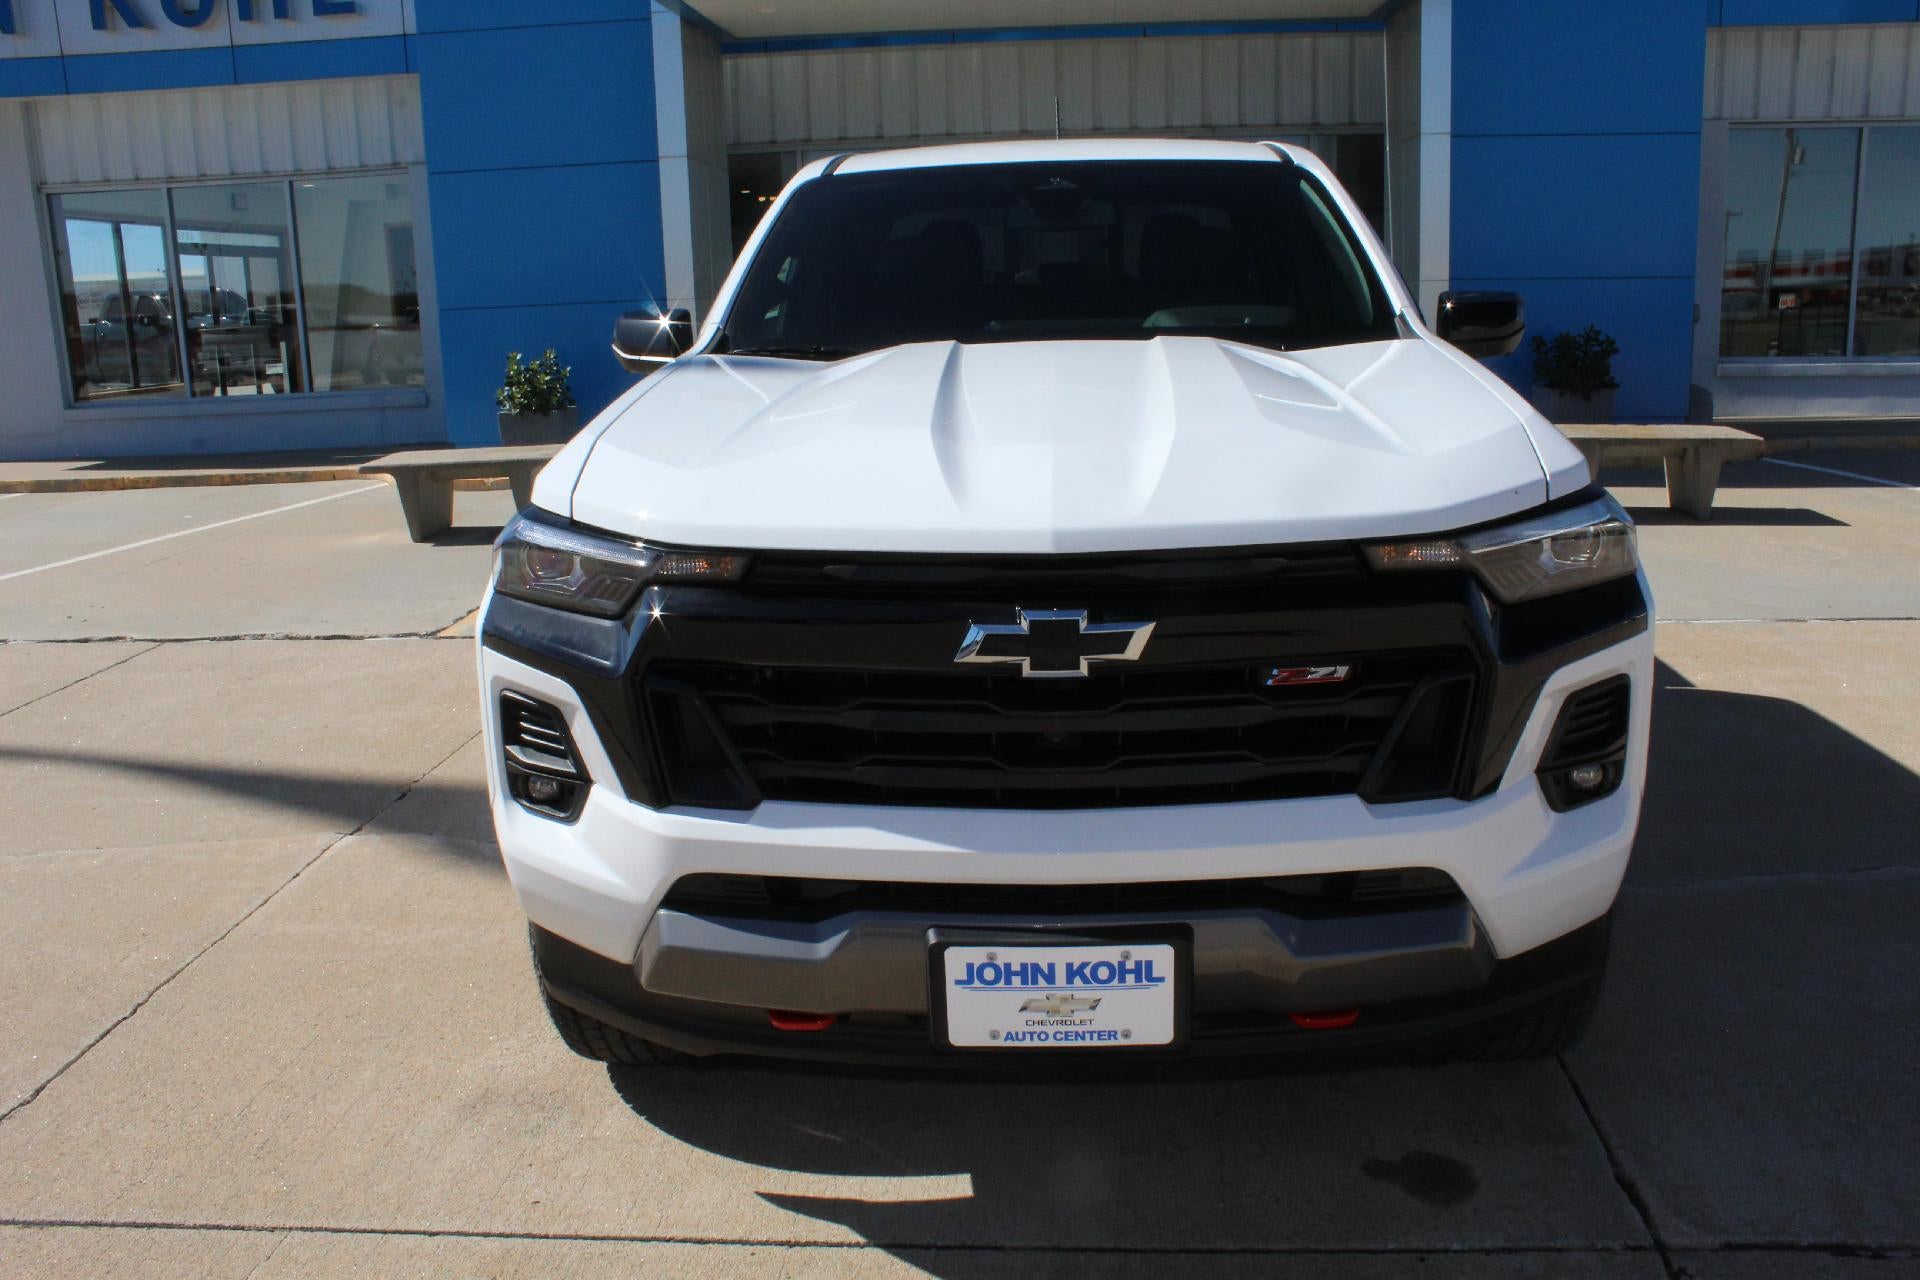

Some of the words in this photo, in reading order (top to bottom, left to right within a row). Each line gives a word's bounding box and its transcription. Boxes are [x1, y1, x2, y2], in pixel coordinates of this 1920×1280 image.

[1266, 665, 1350, 686] Z71
[954, 961, 1056, 986] JOHN
[1065, 960, 1166, 986] KOHL
[1025, 1018, 1095, 1027] CHEVROLET
[1004, 1030, 1049, 1042] AUTO
[1053, 1030, 1119, 1041] CENTER
